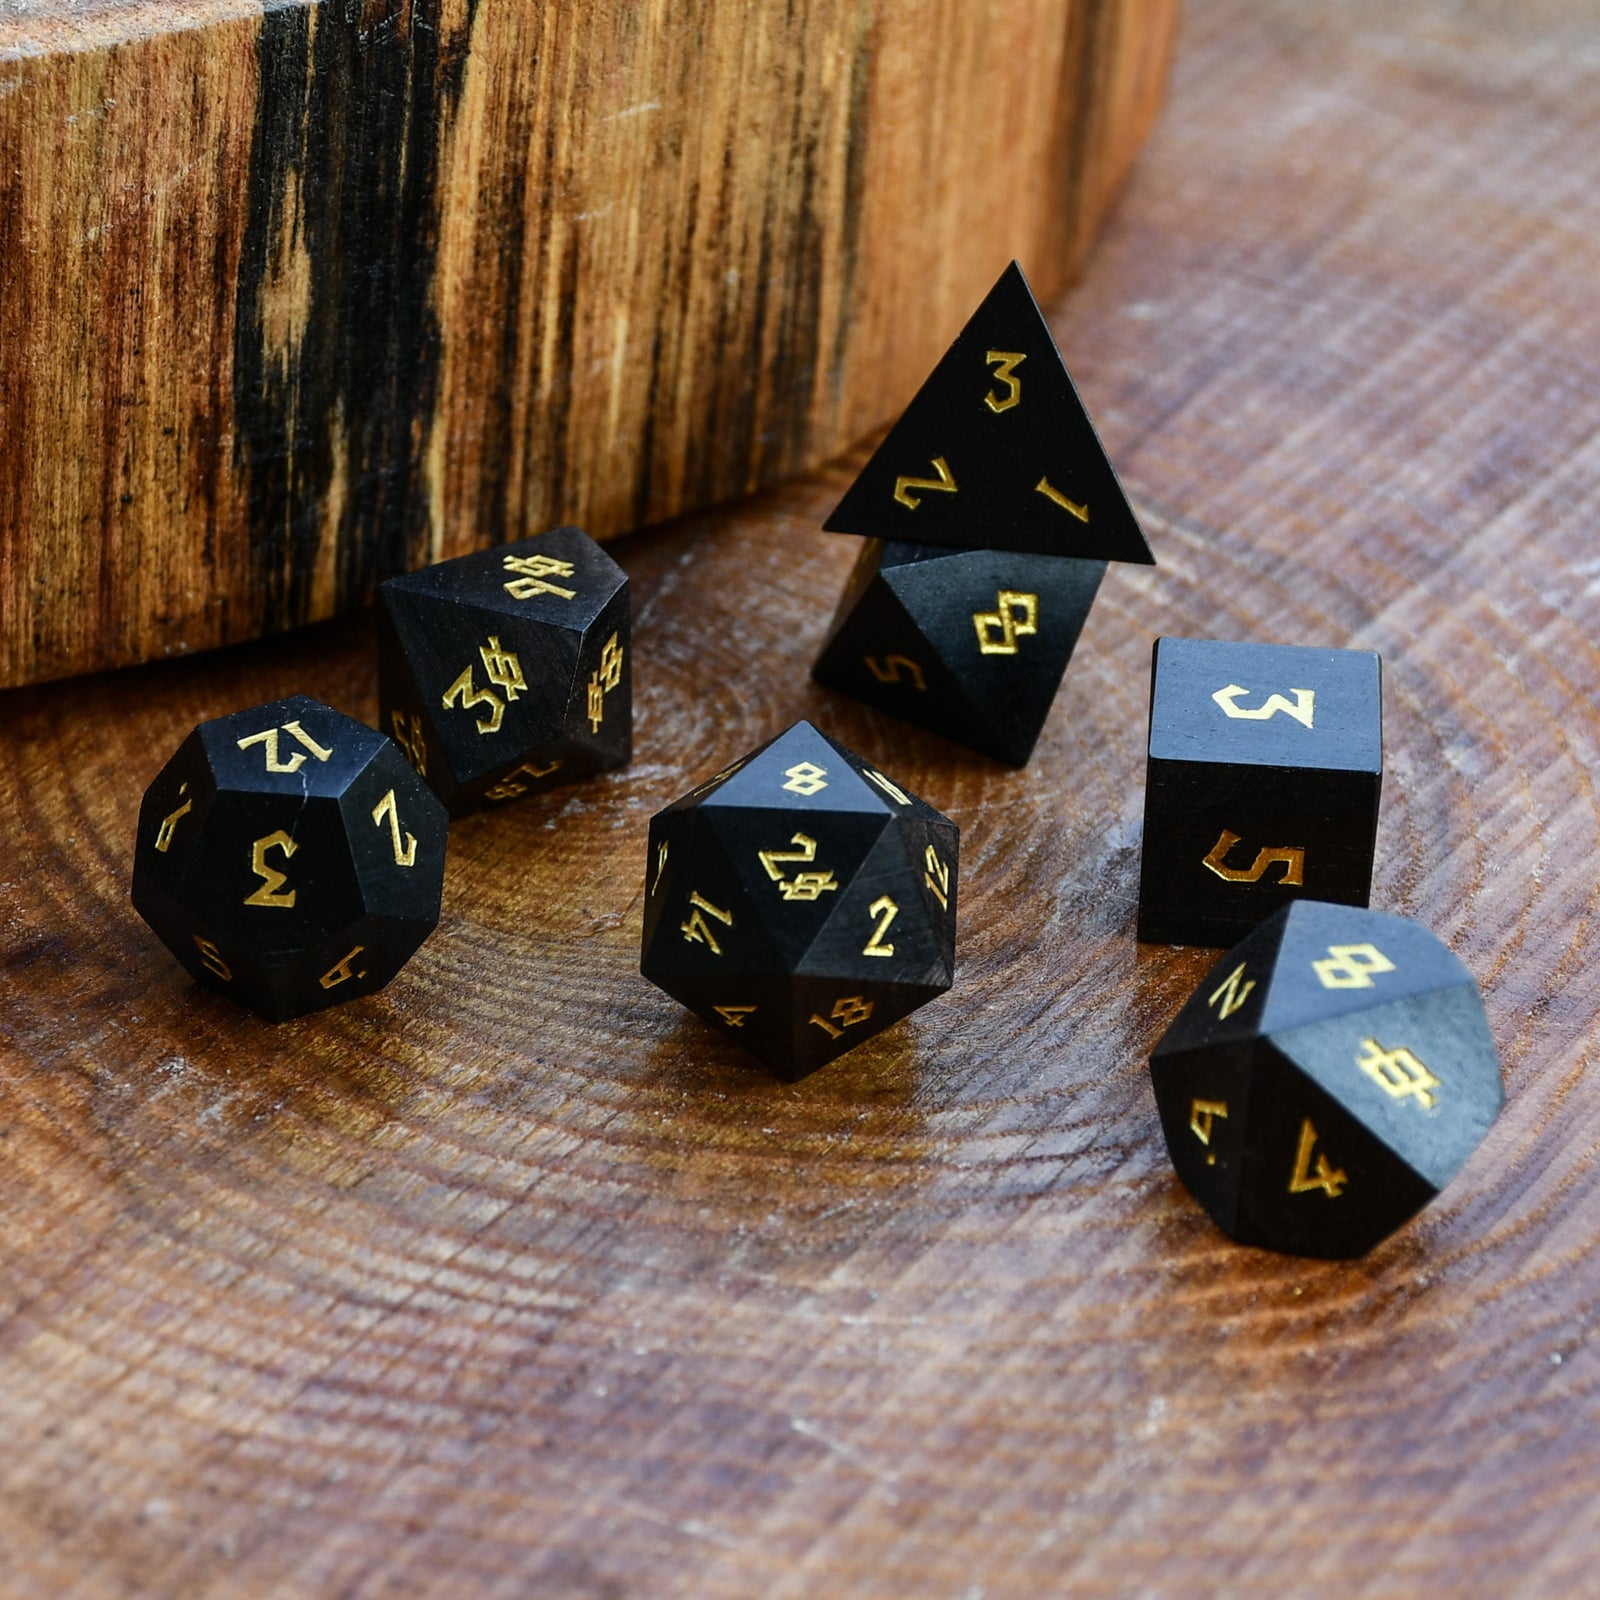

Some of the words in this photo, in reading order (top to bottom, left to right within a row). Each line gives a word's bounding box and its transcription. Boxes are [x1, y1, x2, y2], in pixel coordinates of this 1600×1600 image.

[983, 349, 1027, 414] 3
[893, 456, 958, 511] 2
[1035, 475, 1090, 524] 1
[972, 590, 1039, 655] 8
[1211, 684, 1315, 729] 3
[236, 720, 333, 773] 12
[782, 761, 828, 796] 8
[371, 788, 417, 868] 2
[242, 828, 299, 909] 3
[1201, 829, 1305, 887] 5
[680, 890, 733, 956] 14
[862, 894, 899, 957] 2
[1312, 943, 1396, 989] 8
[712, 1004, 758, 1028] 4
[808, 994, 875, 1040] 18
[1287, 1115, 1349, 1199] 4
